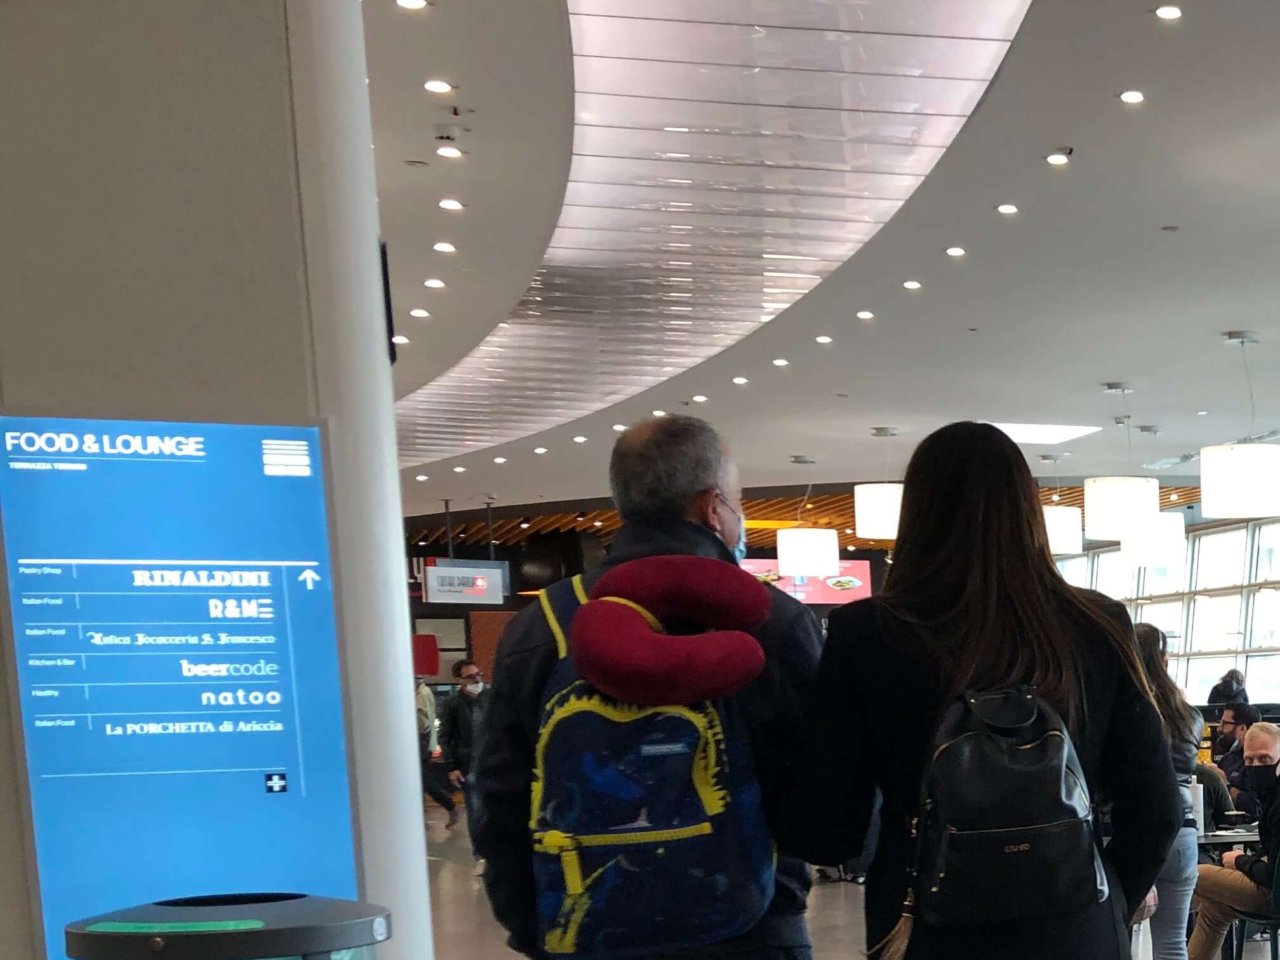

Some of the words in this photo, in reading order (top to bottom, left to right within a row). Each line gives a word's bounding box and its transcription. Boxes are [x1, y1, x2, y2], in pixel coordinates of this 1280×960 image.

[4, 432, 79, 453] FOOD
[82, 434, 100, 453] &
[103, 435, 206, 456] LOUNGE
[132, 570, 271, 587] RINALDINI
[180, 659, 279, 677] beercode
[201, 688, 282, 706] natoo
[105, 723, 123, 736] La
[126, 721, 215, 735] PORCHETTA
[218, 721, 233, 732] di
[236, 720, 285, 732] Ariccia
